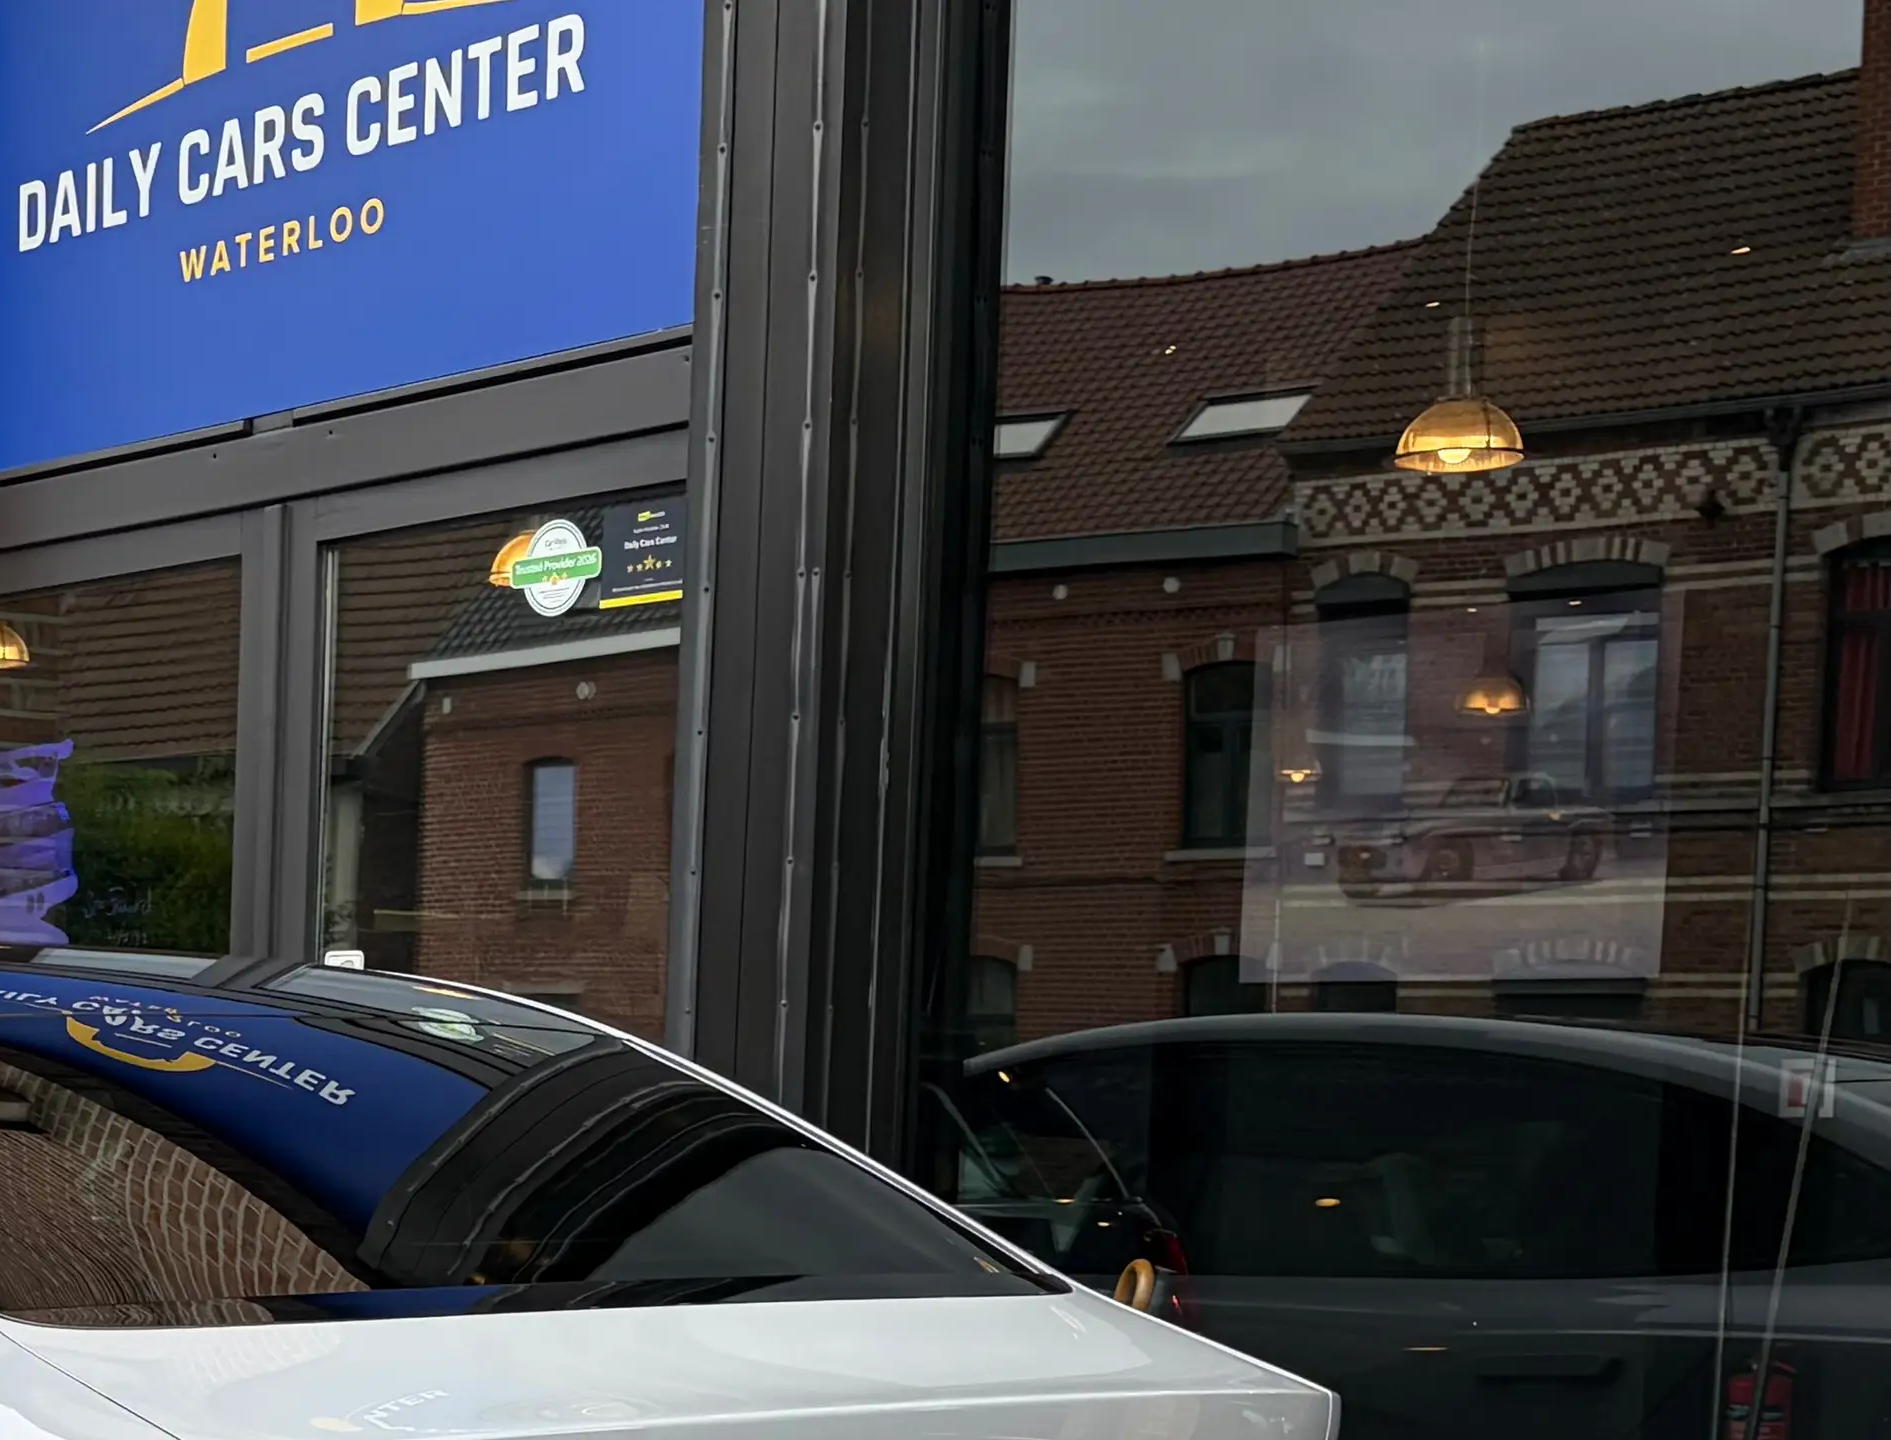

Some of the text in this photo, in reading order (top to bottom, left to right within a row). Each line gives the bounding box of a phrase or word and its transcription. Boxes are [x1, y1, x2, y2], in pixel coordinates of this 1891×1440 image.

[18, 14, 585, 252] DAILY CARS CENTER
[179, 197, 386, 283] WATERLOO
[543, 556, 576, 572] Provider
